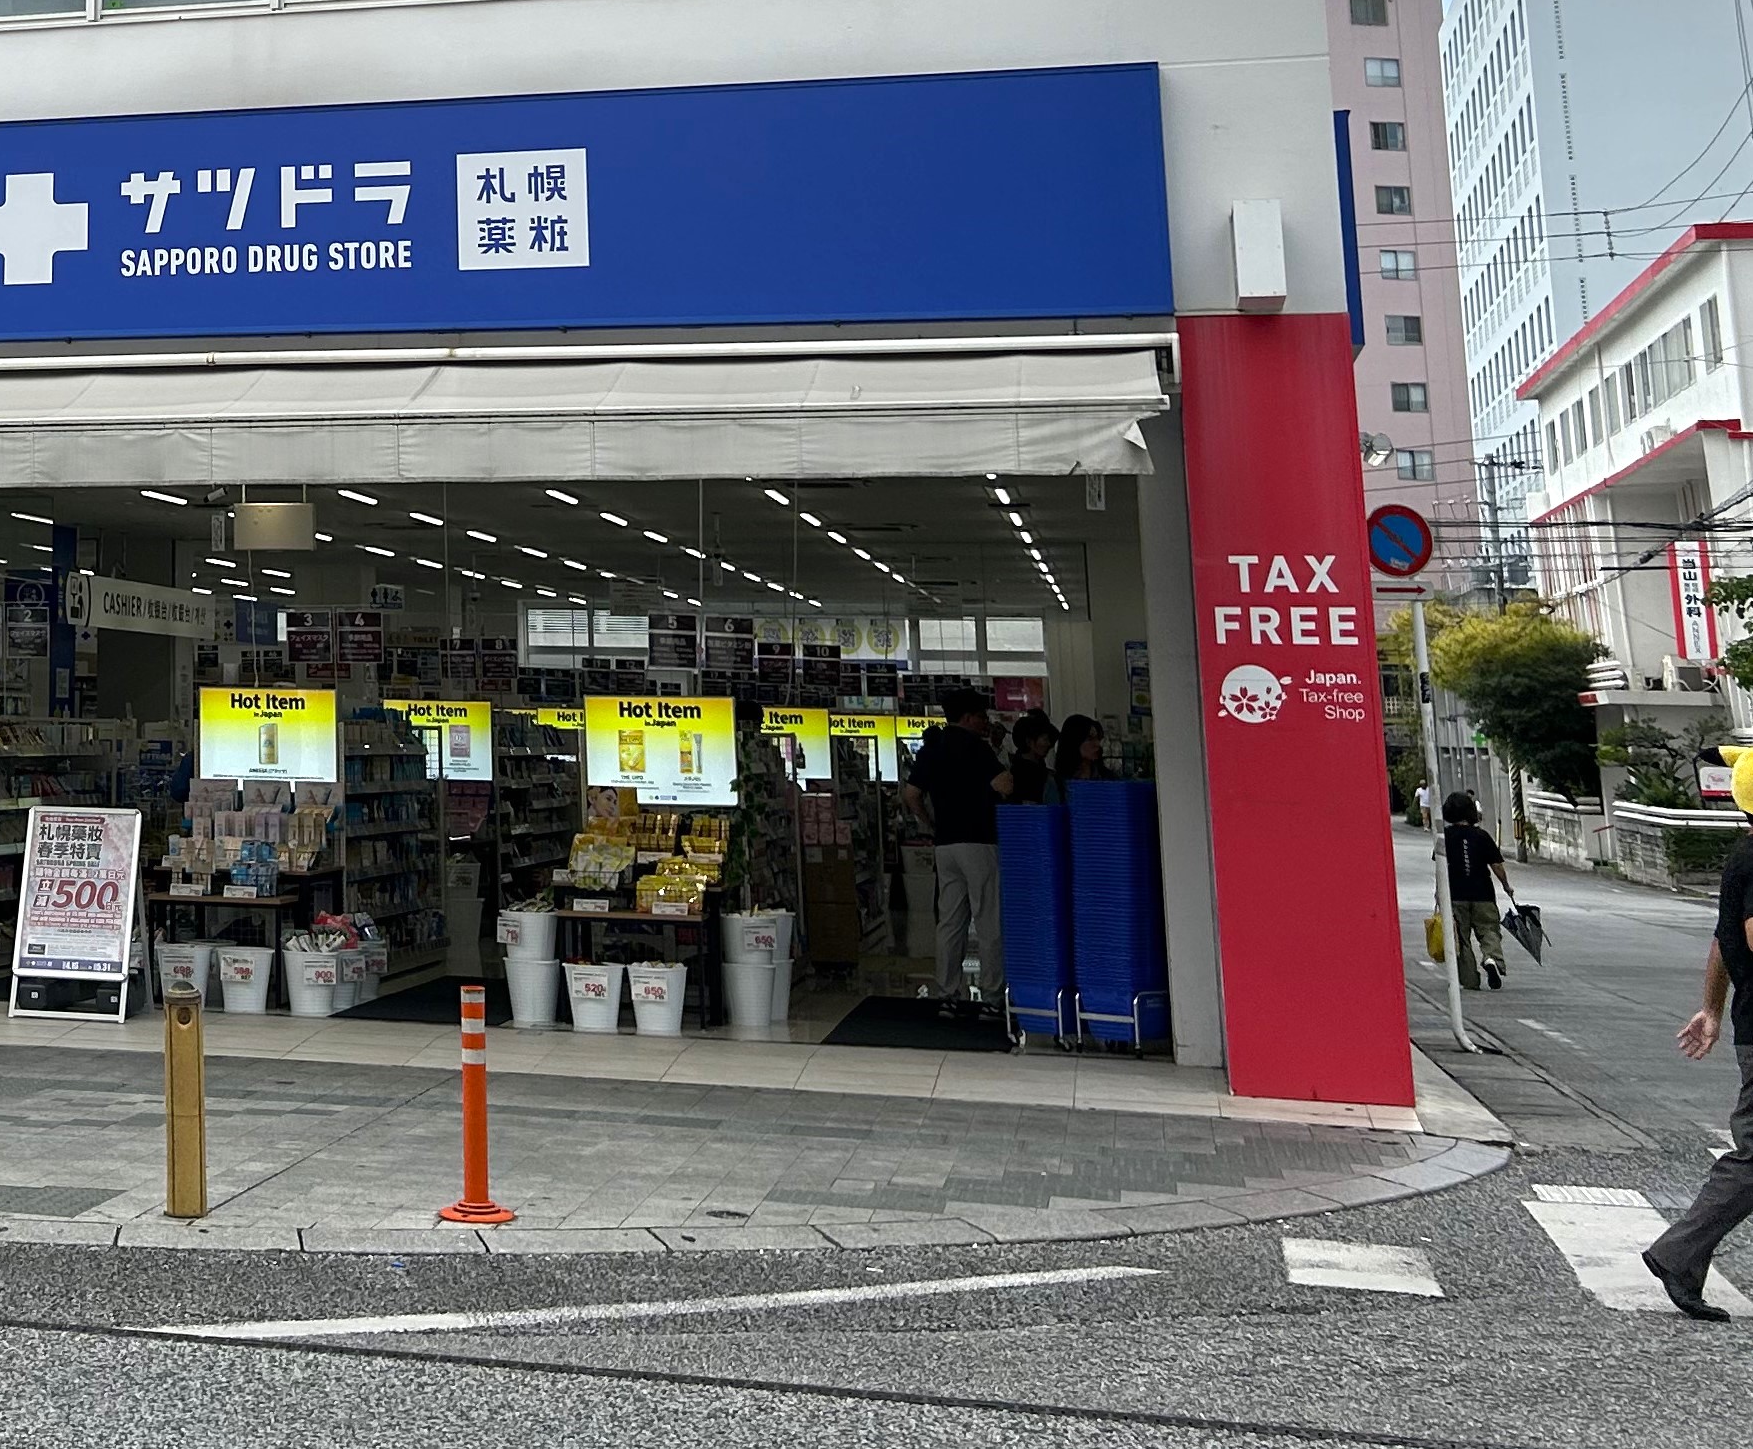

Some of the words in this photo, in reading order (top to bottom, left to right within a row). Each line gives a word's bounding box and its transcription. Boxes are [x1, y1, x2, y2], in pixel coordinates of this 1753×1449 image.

[476, 164, 568, 204] 札幌
[120, 160, 411, 233] サツドラ
[476, 215, 570, 255] 薬粧
[120, 244, 237, 277] SAPPORO
[248, 242, 318, 274] DRUG
[328, 240, 412, 270] STORE
[1227, 554, 1340, 594] TAX
[103, 592, 142, 618] CASHIER
[23, 610, 32, 622] 2
[304, 613, 313, 626] 3
[355, 613, 365, 626] 4
[667, 616, 678, 629] 5
[724, 618, 735, 632] 6
[1214, 606, 1360, 645] FREE
[1304, 669, 1363, 688] Japan.
[230, 693, 261, 709] Hot
[266, 693, 306, 710] Item
[1299, 688, 1365, 703] Tax-free
[260, 710, 282, 719] Japan
[408, 704, 433, 717] Hot
[436, 705, 468, 718] Item
[557, 711, 577, 723] Hot
[618, 701, 653, 719] Hot
[657, 702, 702, 719] Item
[769, 711, 803, 725] Item
[1324, 704, 1365, 722] Shop
[652, 719, 676, 728] Japan
[848, 717, 875, 729] Item
[51, 879, 120, 910] 500
